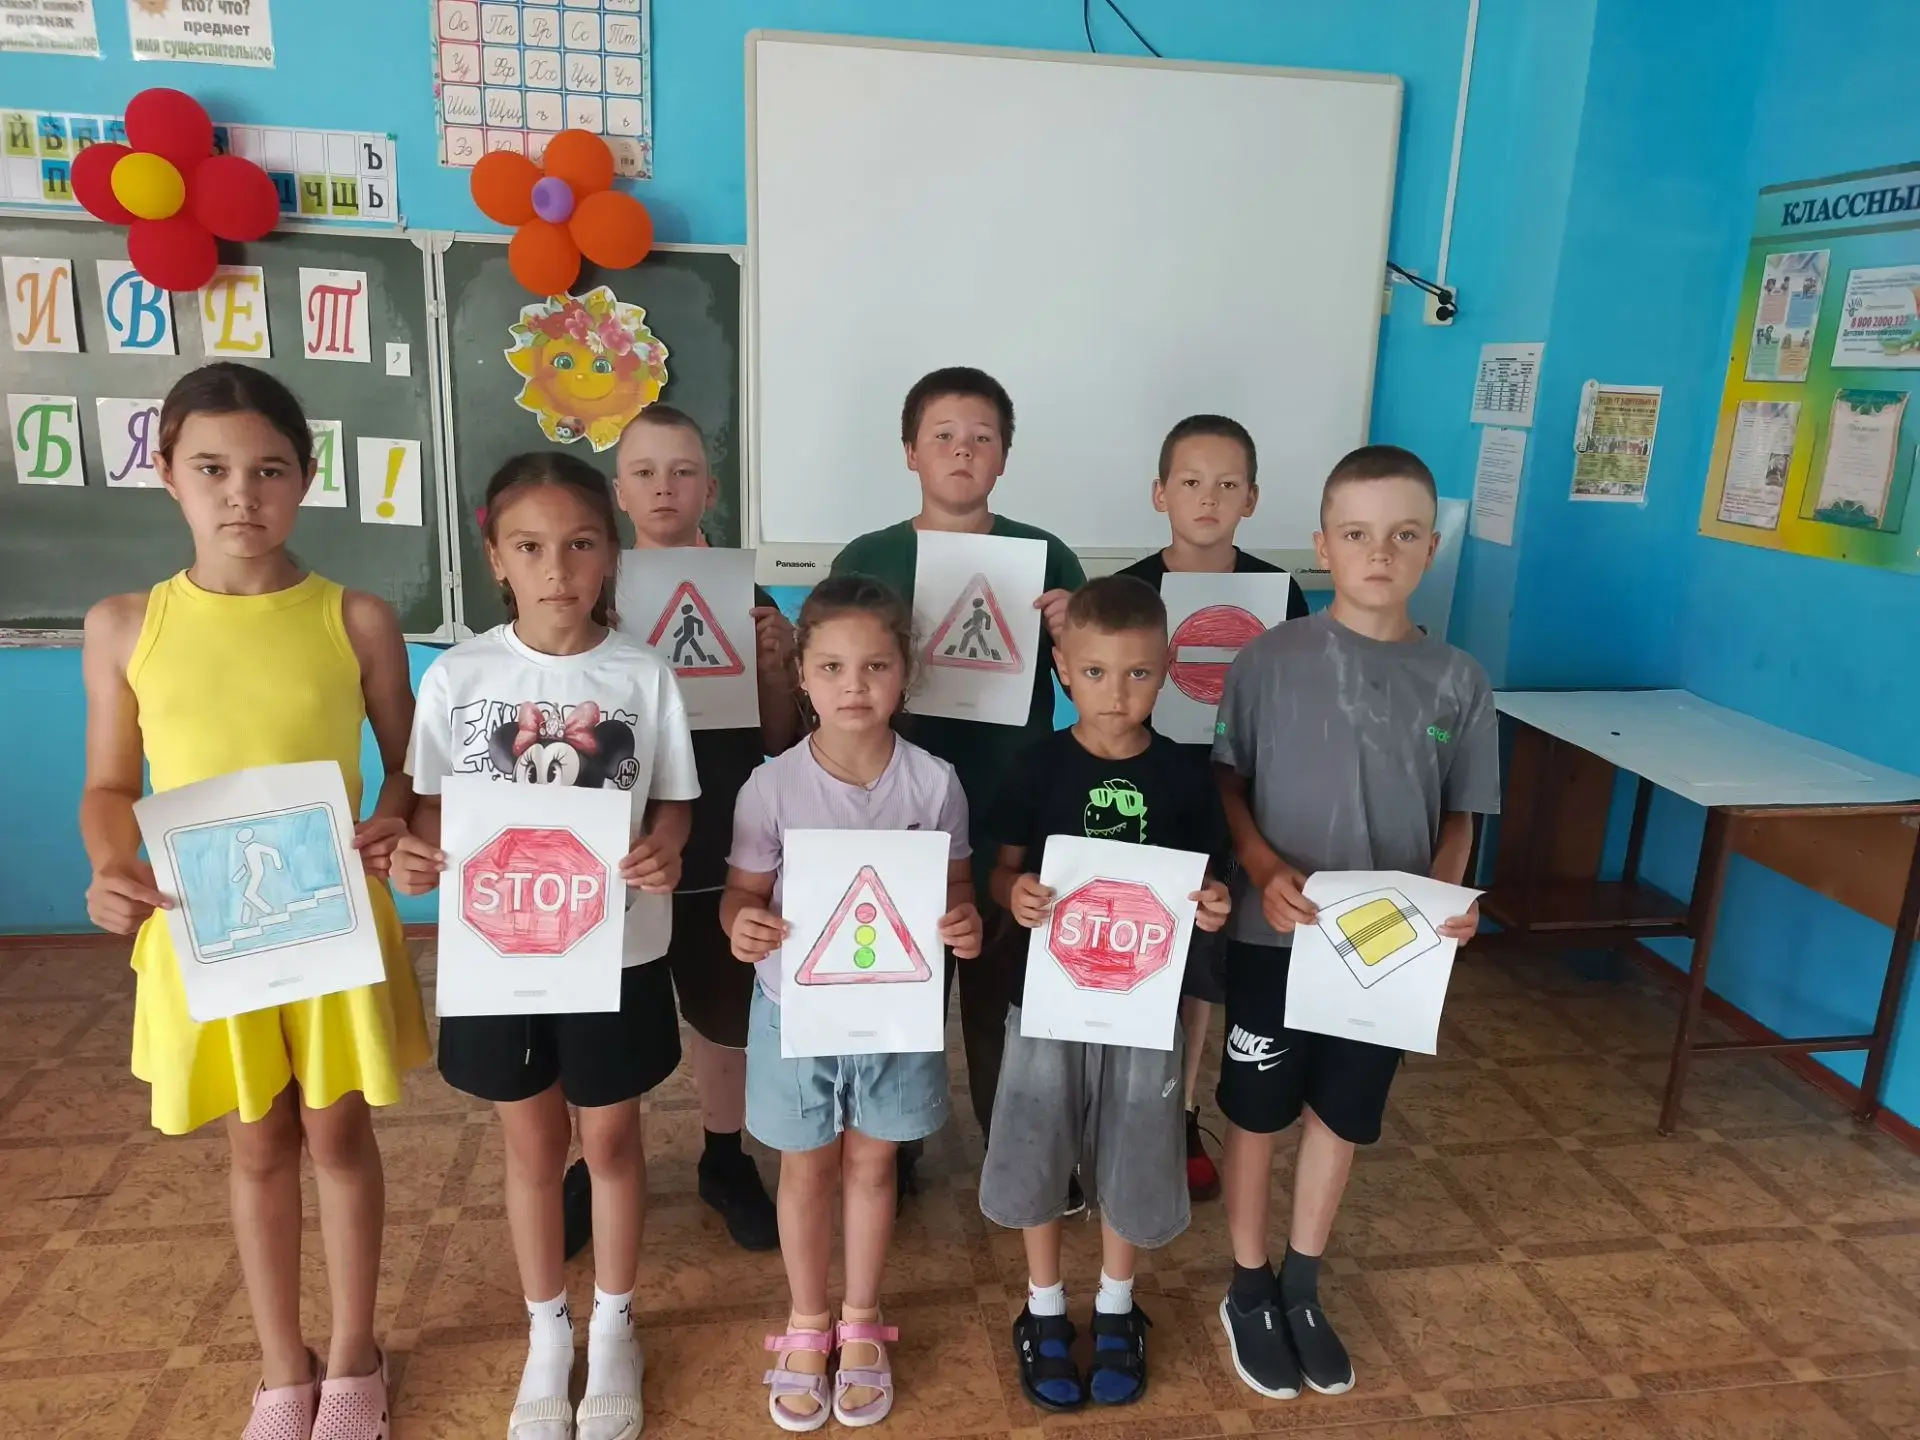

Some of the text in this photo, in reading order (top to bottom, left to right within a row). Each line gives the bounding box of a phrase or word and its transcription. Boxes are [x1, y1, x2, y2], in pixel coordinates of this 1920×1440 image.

[184, 21, 251, 37] предмет
[48, 167, 68, 192] П
[304, 181, 323, 207] Ч
[331, 181, 359, 210] Щ
[776, 560, 816, 568] Panasonic
[471, 870, 600, 913] STOP
[1057, 911, 1167, 955] STOP
[1230, 1024, 1274, 1056] NIKE
